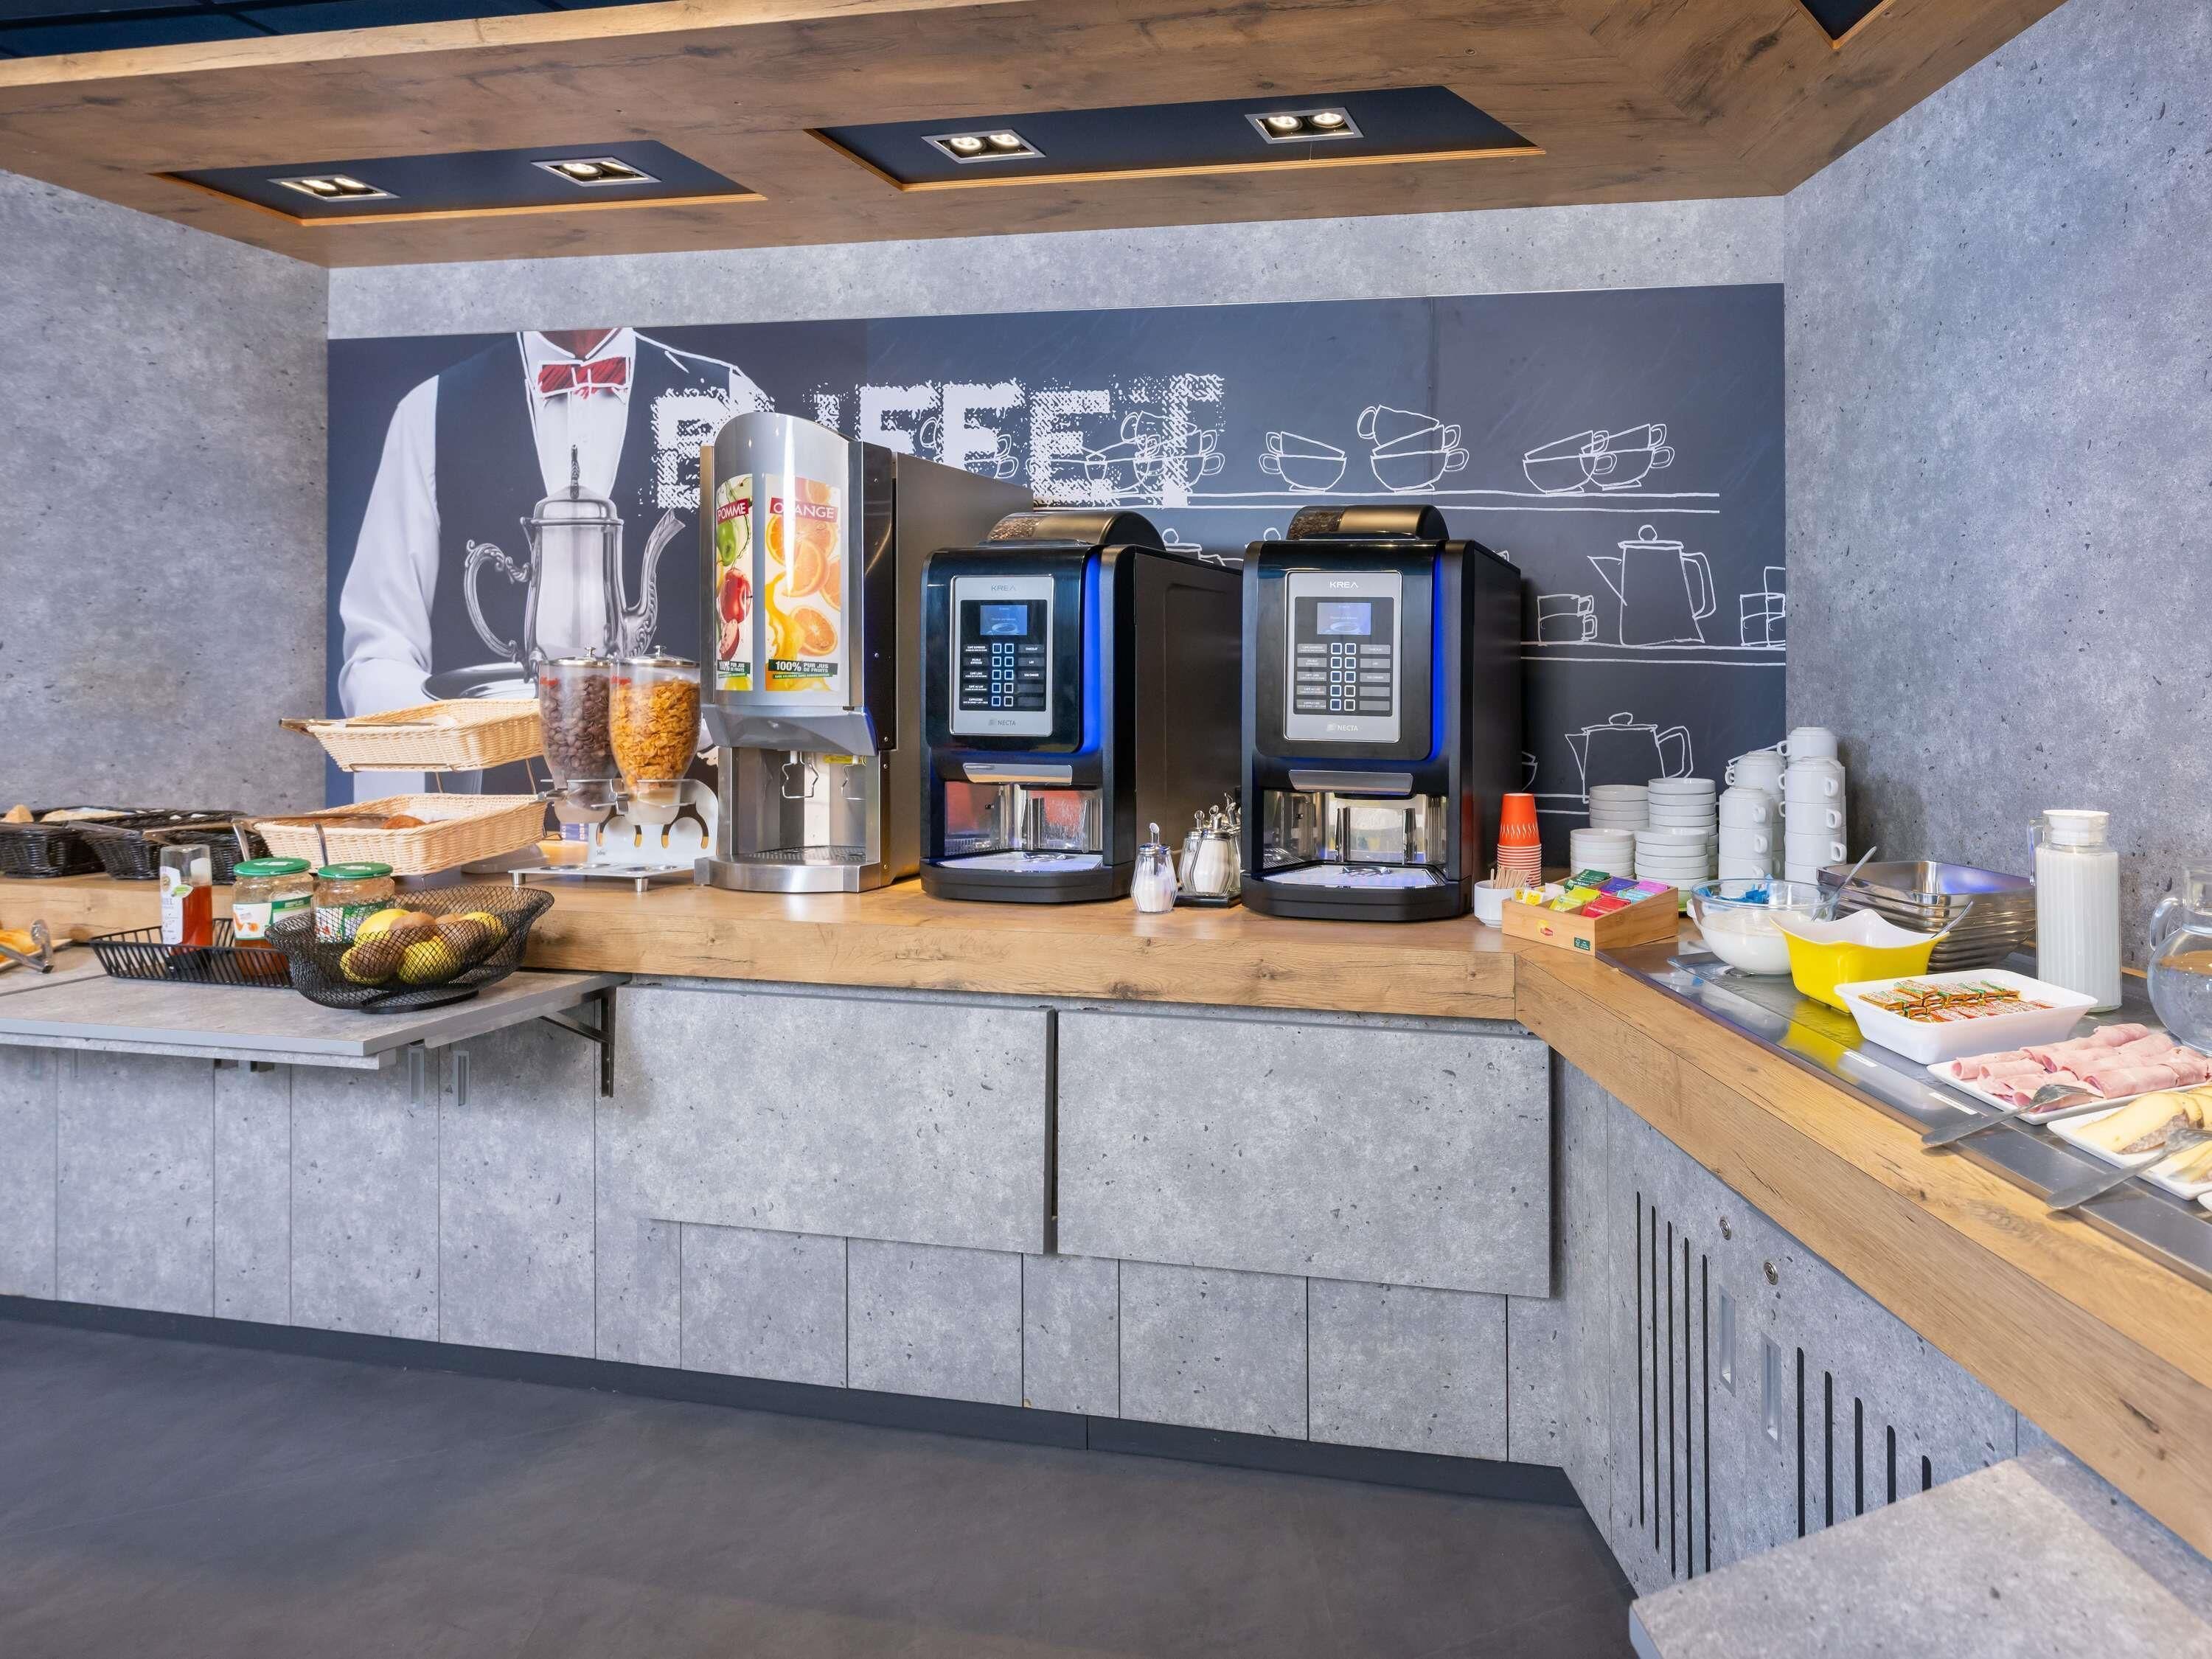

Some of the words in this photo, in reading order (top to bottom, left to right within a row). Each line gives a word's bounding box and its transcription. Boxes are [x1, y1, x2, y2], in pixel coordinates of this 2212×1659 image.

[650, 373, 1225, 509] BFFET
[717, 502, 746, 521] POMME
[773, 503, 834, 518] OANGE
[775, 661, 801, 672] 100%
